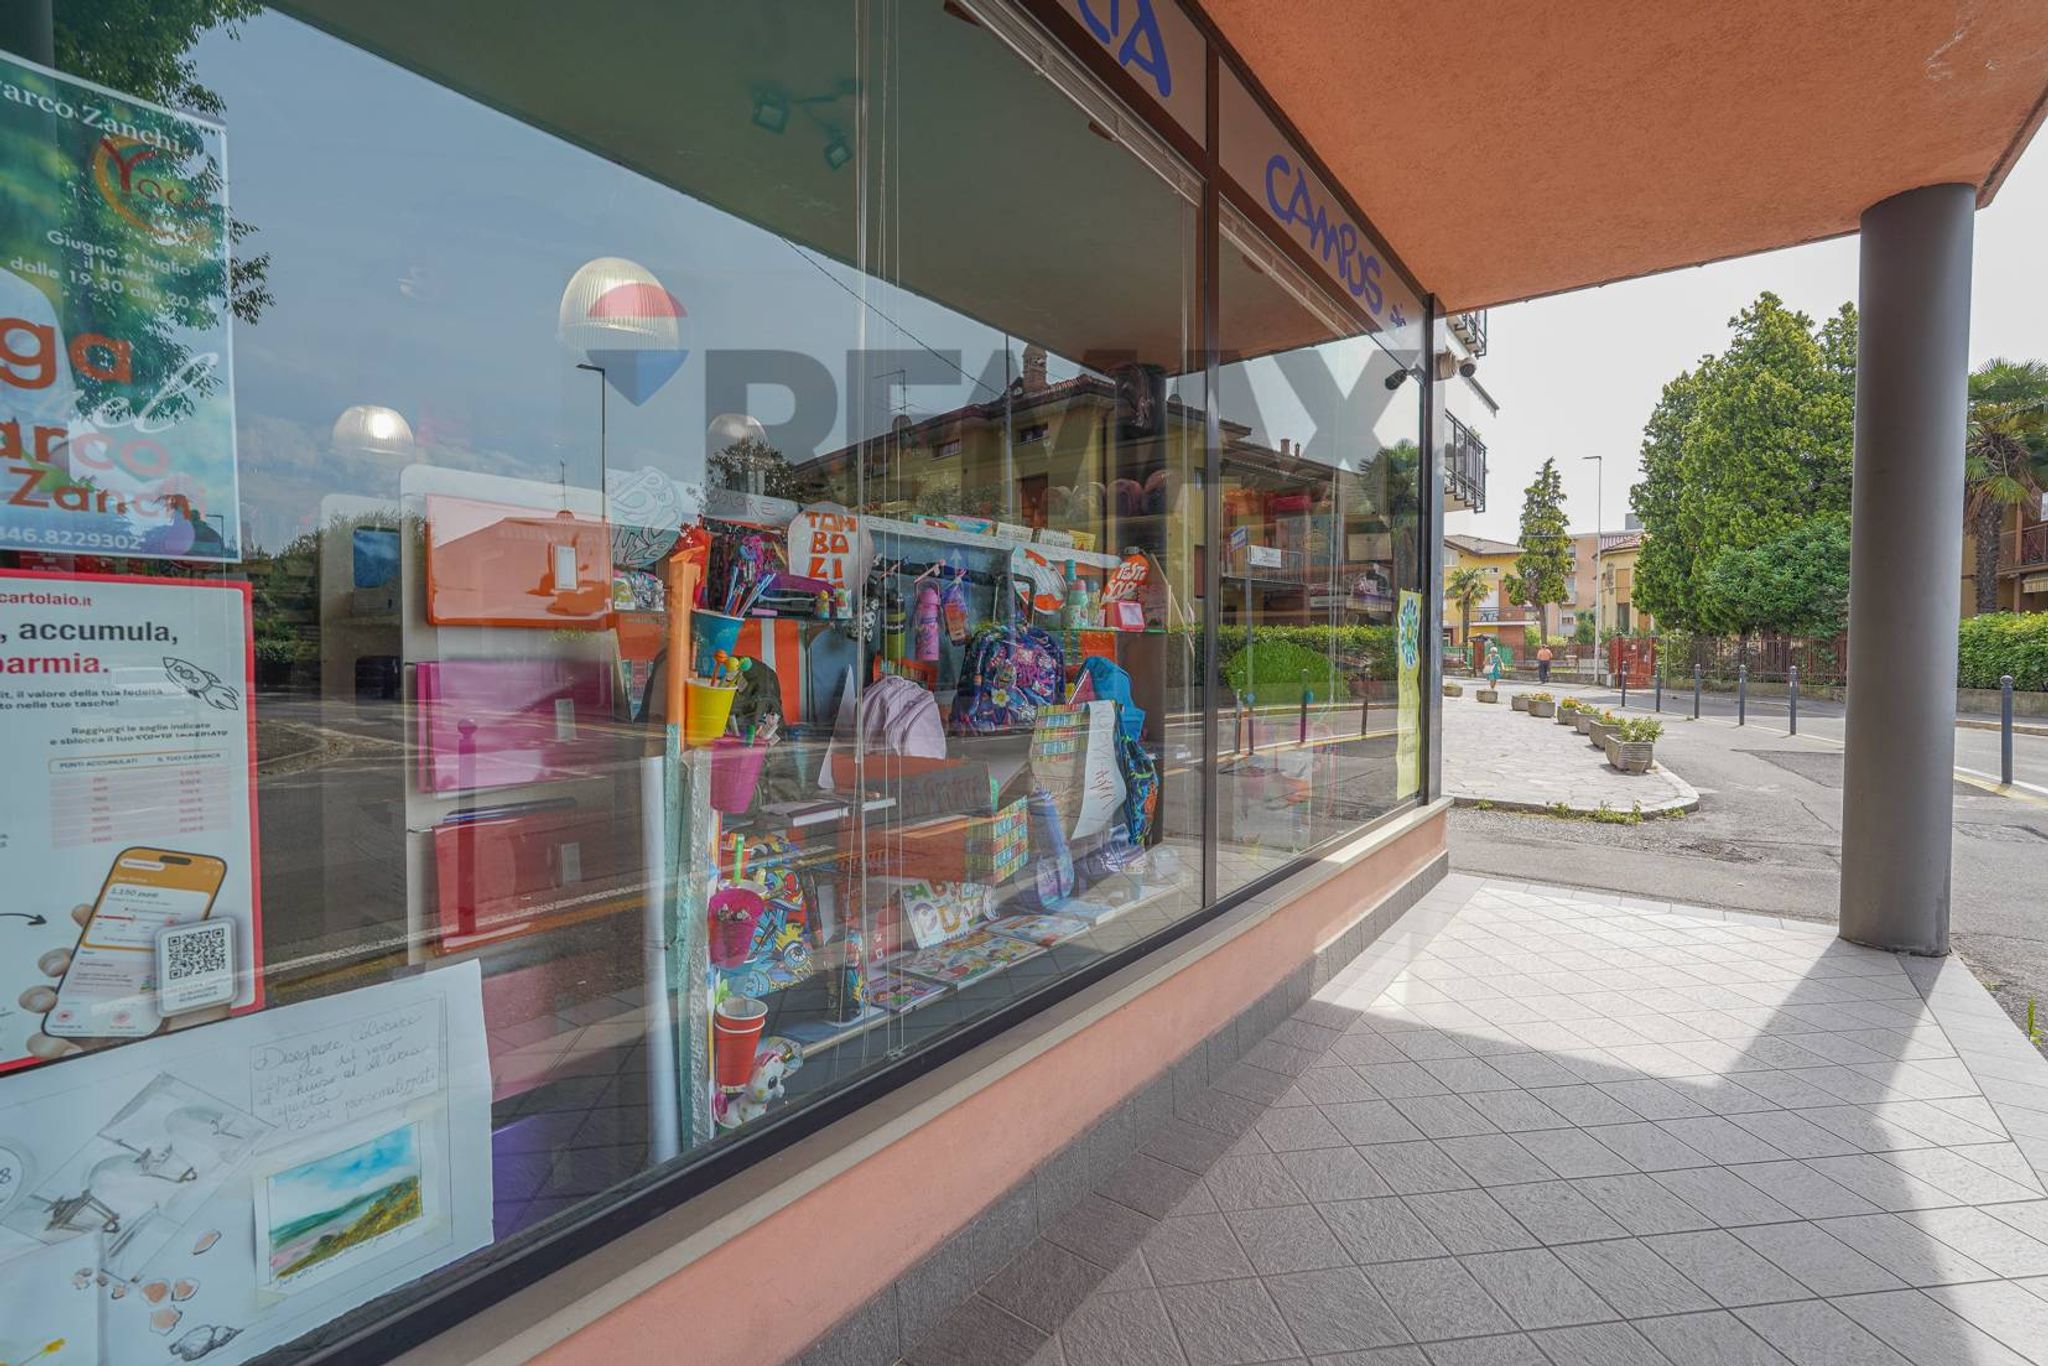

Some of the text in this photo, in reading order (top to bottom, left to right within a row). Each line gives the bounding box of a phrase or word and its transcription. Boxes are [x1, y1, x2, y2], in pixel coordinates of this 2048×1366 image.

[83, 105, 181, 153] Zanchi
[47, 230, 118, 259] Giugno
[141, 252, 191, 277] Luglio
[1265, 154, 1382, 315] CAMPUS
[10, 256, 60, 280] dalle
[19, 621, 179, 645] accumula,
